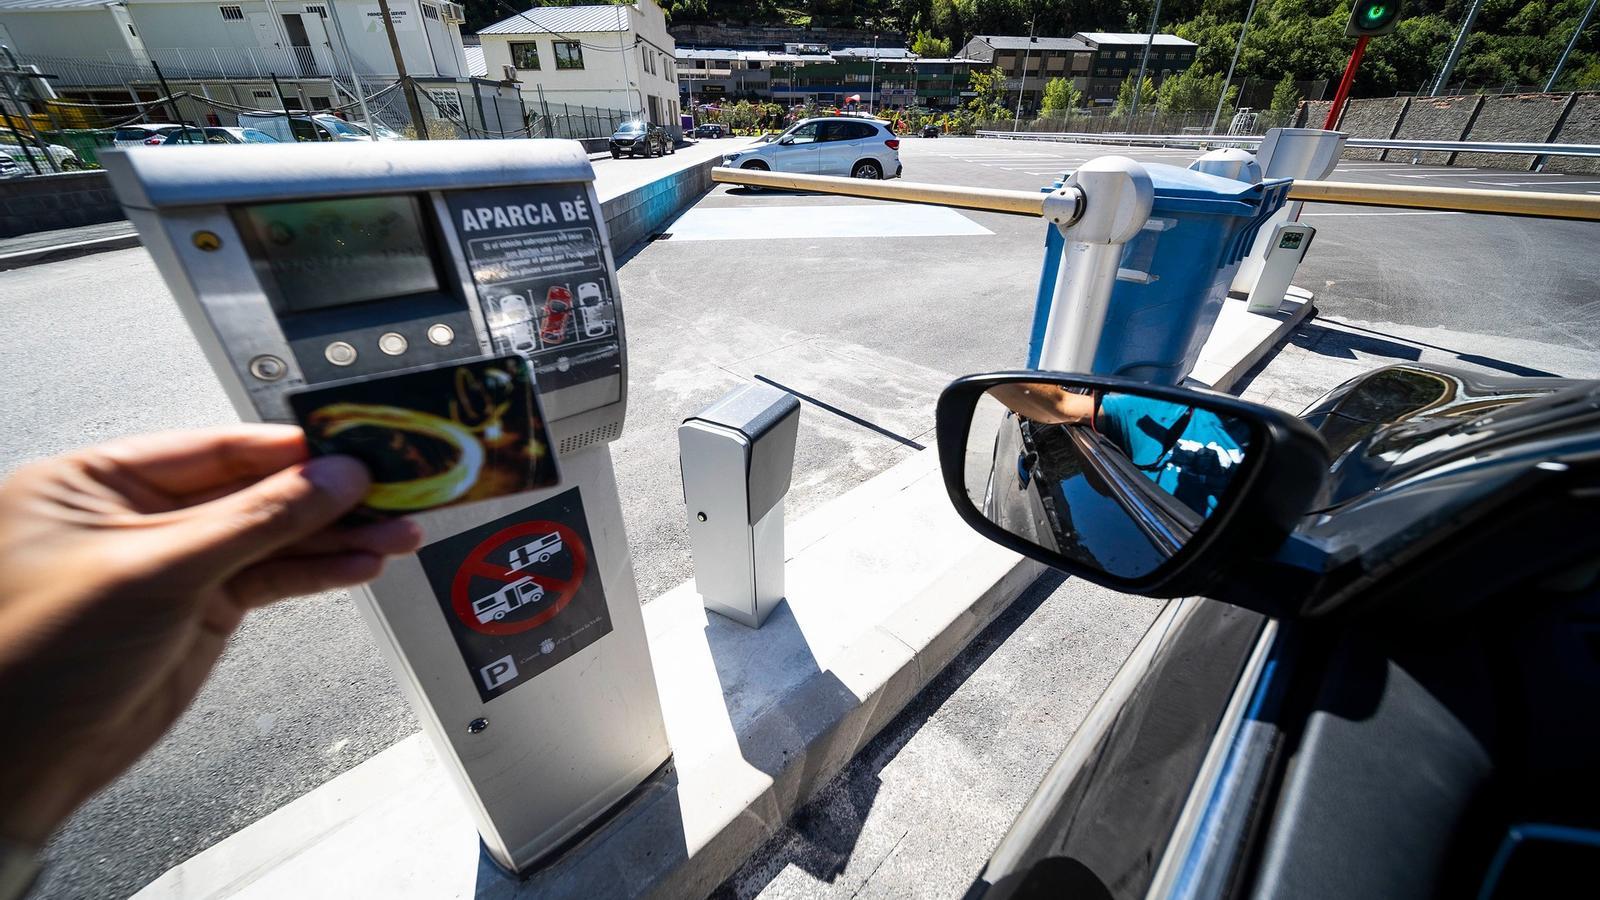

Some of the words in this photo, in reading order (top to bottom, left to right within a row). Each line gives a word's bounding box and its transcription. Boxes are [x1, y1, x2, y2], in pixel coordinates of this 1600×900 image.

[462, 203, 557, 231] APARCA
[560, 195, 590, 222] BÉ
[486, 662, 508, 685] P
